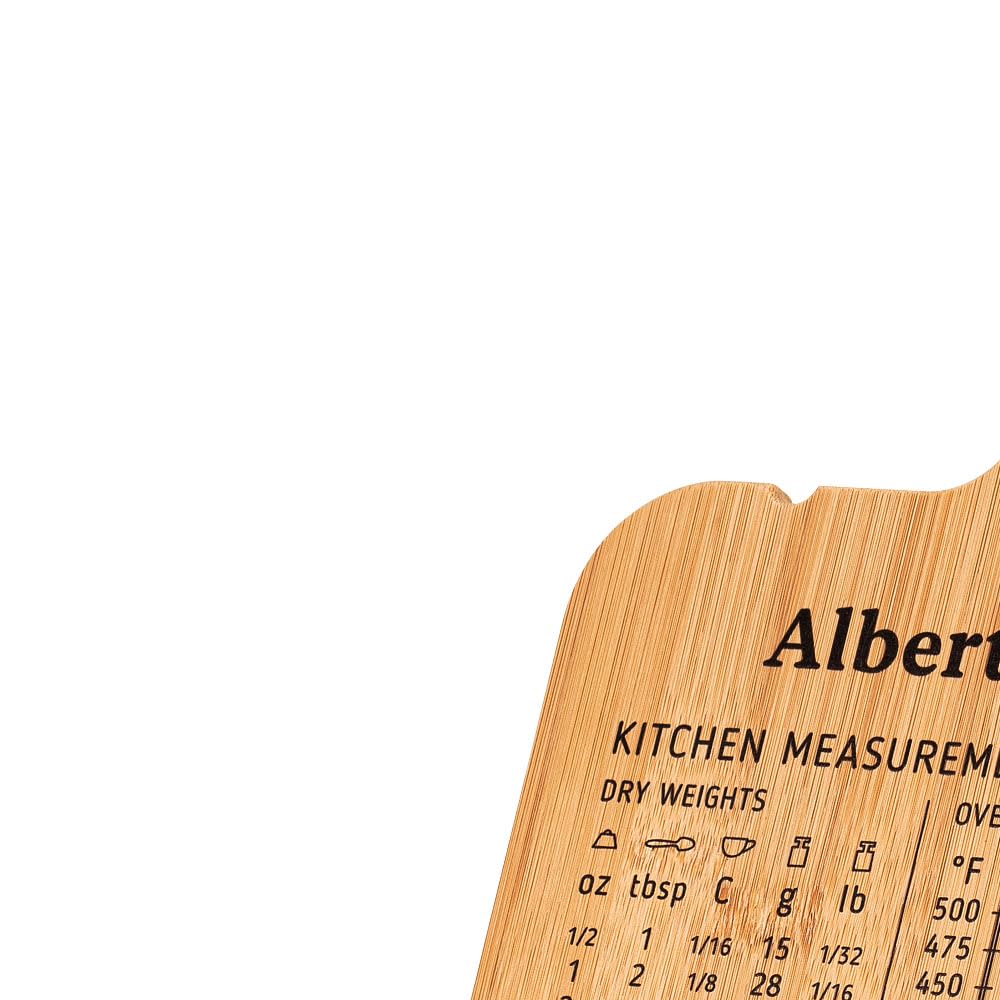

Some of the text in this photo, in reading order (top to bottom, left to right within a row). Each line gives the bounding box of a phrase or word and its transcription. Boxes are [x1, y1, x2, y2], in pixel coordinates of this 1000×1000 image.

[612, 720, 767, 764] KITCHEN
[600, 778, 768, 812] DRY WEIGHTS
[578, 872, 867, 918] oz tbsp C g lb
[931, 896, 981, 923] 500
[569, 926, 863, 966] 1/2 1/16 15 1/32
[923, 933, 972, 961] 475
[688, 972, 718, 993] 1/8
[749, 971, 783, 998] 28
[915, 970, 963, 998] 450
